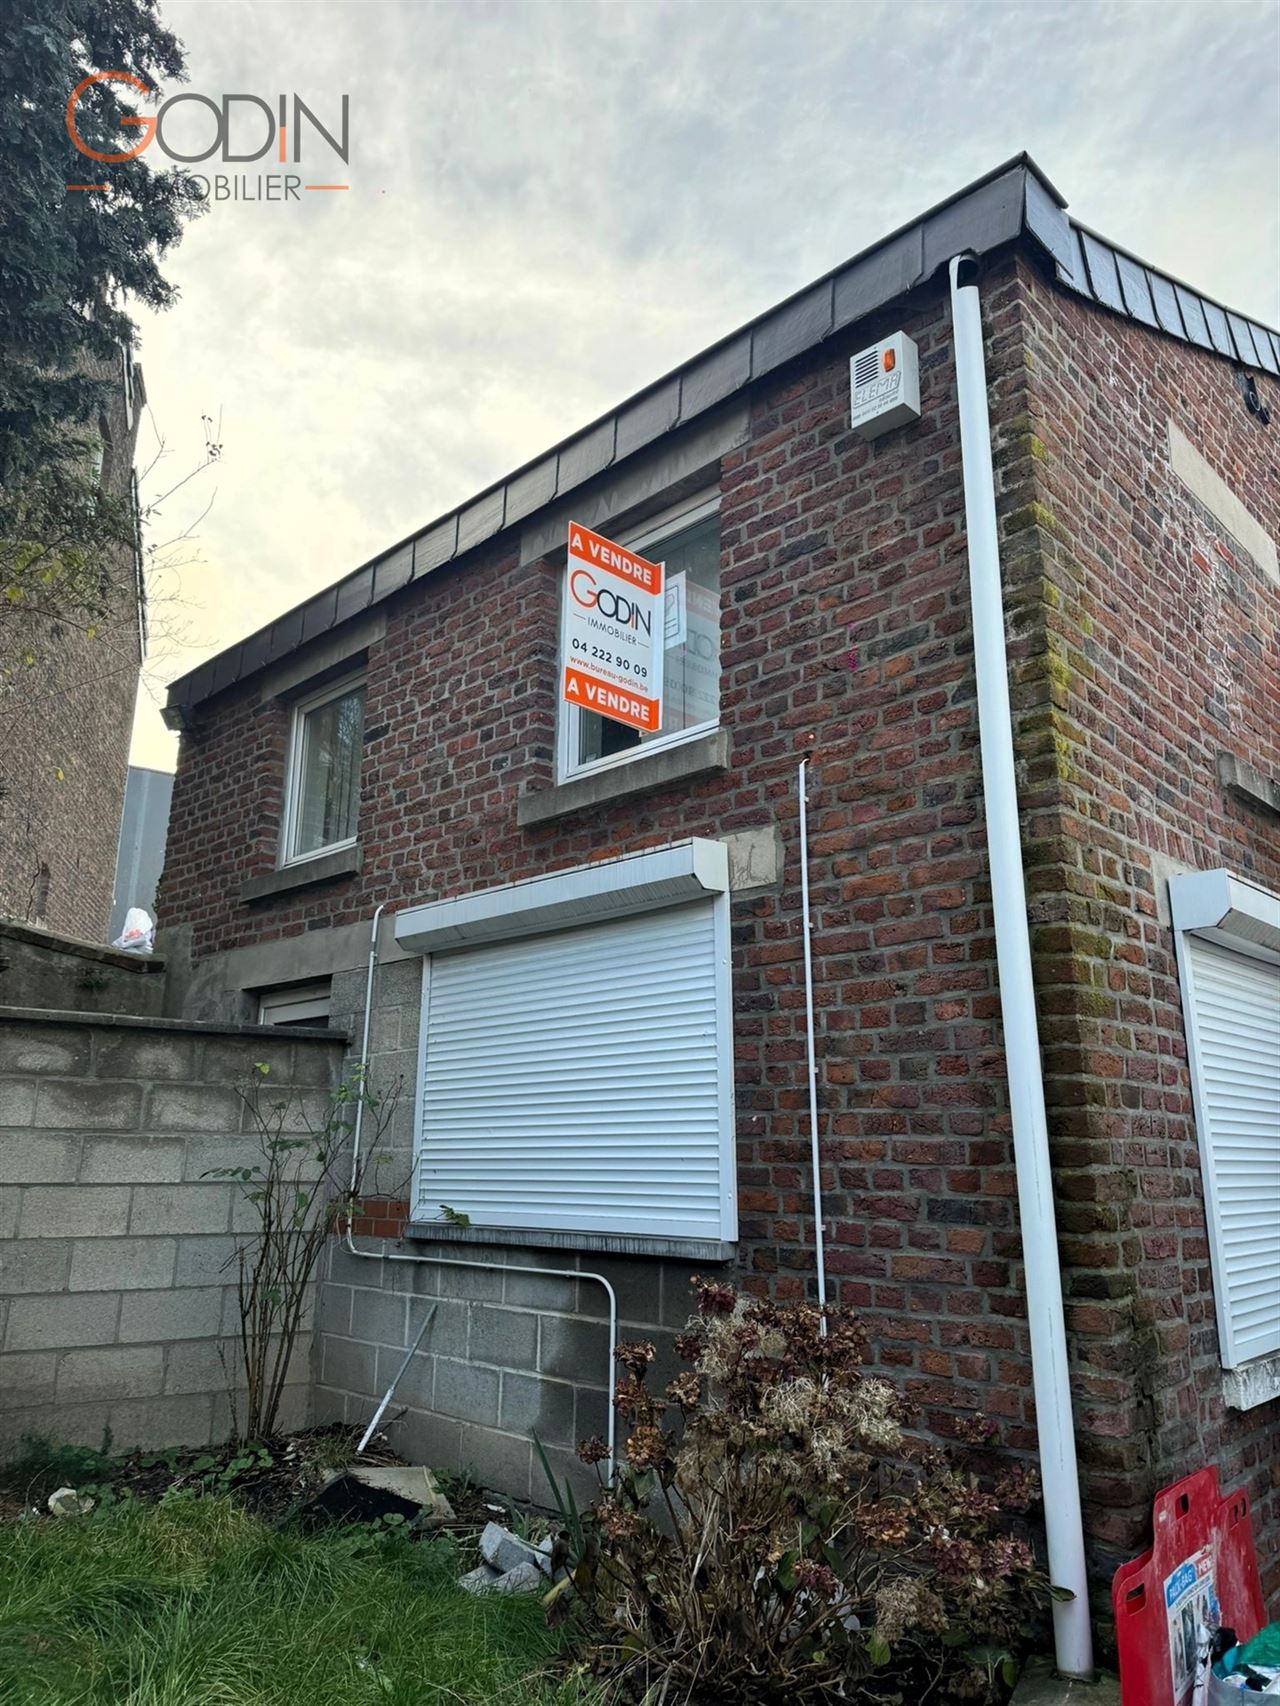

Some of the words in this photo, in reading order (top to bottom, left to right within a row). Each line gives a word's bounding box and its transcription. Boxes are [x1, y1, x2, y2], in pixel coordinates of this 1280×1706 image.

[571, 532, 584, 552] A
[589, 540, 652, 586] VENDRE
[570, 569, 652, 637] GODIN
[587, 616, 637, 646] IMMOBILIER
[570, 655, 648, 692] www.bureau-godin.be
[572, 638, 587, 653] 04
[592, 646, 612, 663] 222
[616, 656, 630, 670] 90
[634, 664, 647, 677] 09
[567, 677, 579, 696] A
[585, 682, 650, 722] VENDRE
